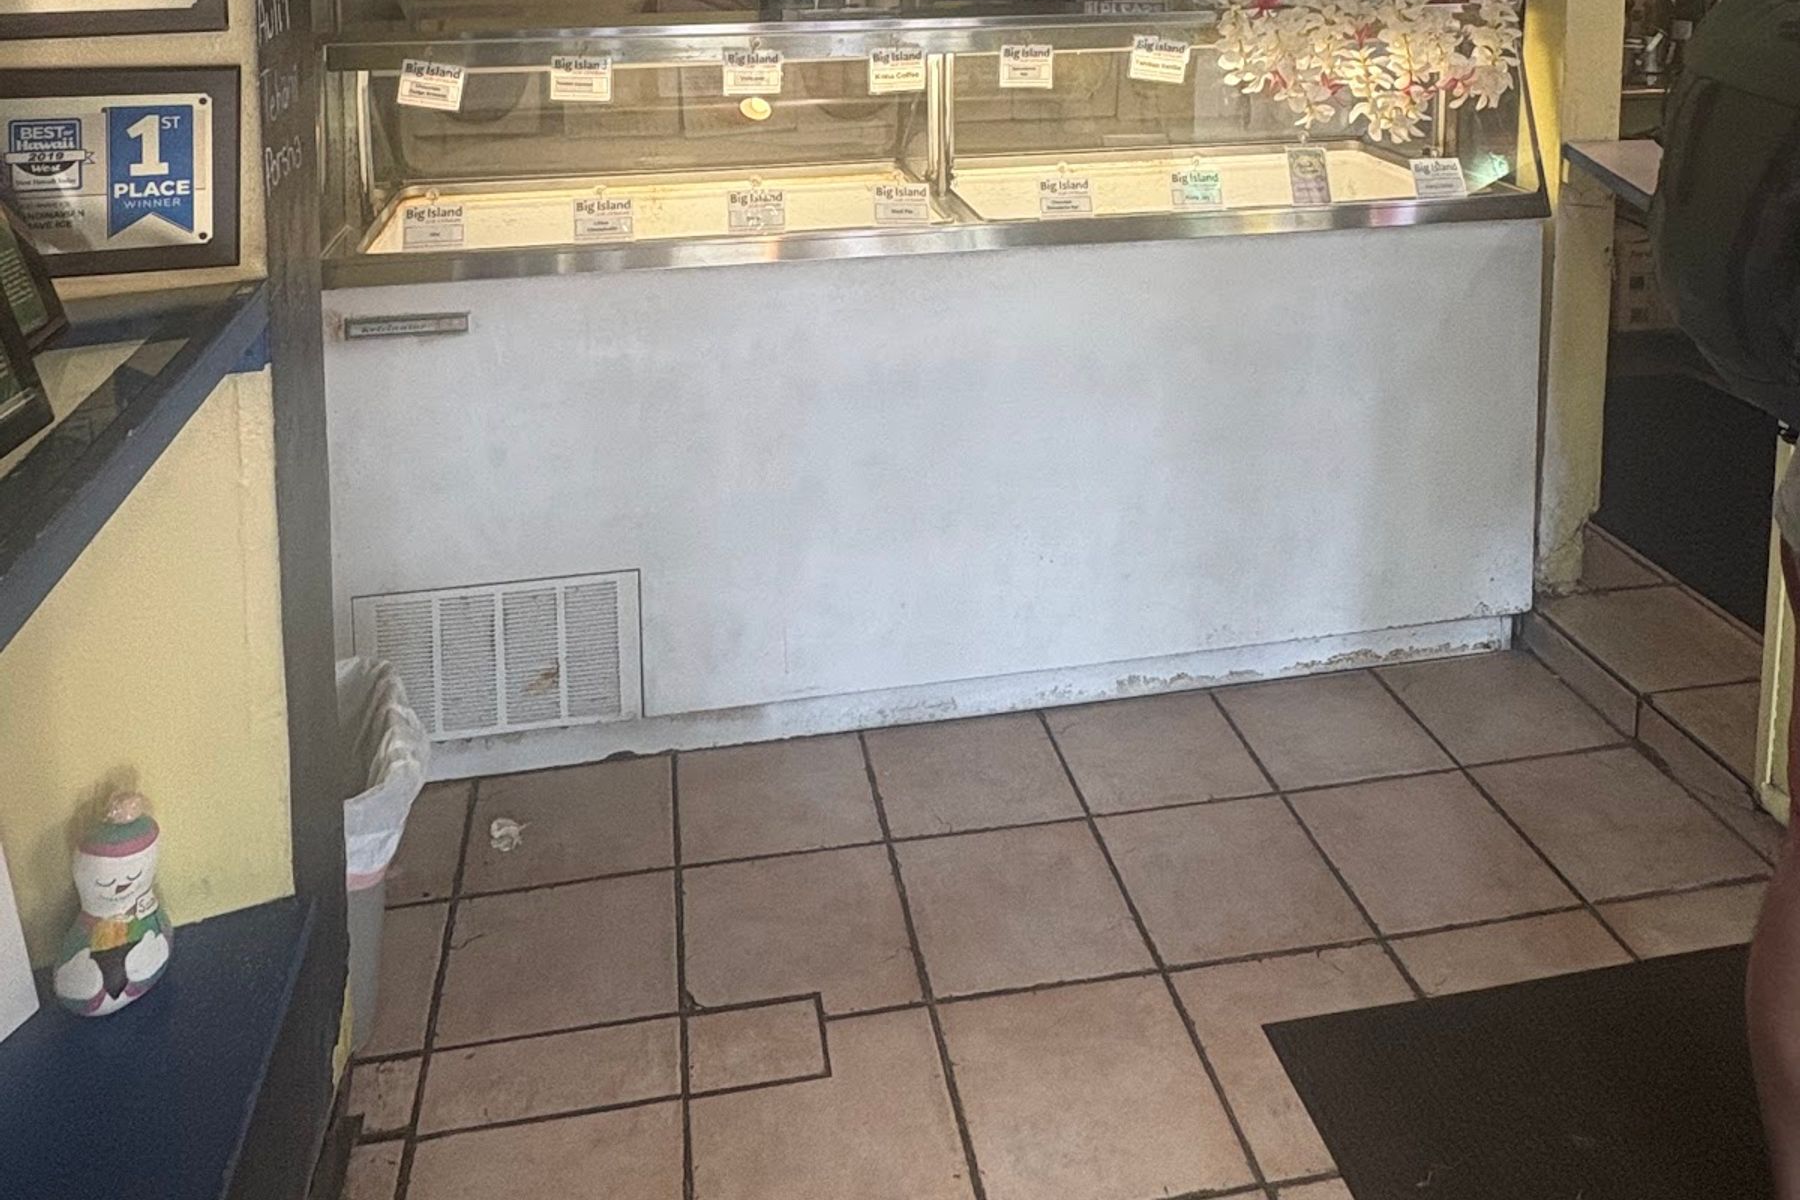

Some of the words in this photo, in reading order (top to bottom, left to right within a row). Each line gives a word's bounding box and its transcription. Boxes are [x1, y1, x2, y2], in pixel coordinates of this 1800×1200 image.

[1003, 46, 1020, 60] Big
[1021, 46, 1050, 58] Island
[1155, 41, 1186, 54] Island
[727, 51, 745, 67] Big
[747, 52, 779, 64] Island
[872, 50, 890, 64] Big
[891, 50, 922, 60] Island
[405, 61, 424, 78] Big
[426, 62, 461, 80] Island
[554, 58, 573, 72] Big
[20, 125, 63, 139] BEST
[16, 137, 75, 151] Hawaii
[28, 151, 65, 161] 2019
[31, 162, 61, 173] West
[1171, 172, 1189, 186] Big
[1190, 172, 1219, 183] Island
[113, 180, 191, 199] PLACE
[876, 187, 893, 200] Big
[895, 187, 926, 198] Island
[1040, 179, 1057, 194] Big
[1059, 179, 1089, 191] Island
[124, 197, 182, 209] WINNER
[730, 193, 748, 207] Big
[406, 208, 425, 222] Big
[427, 206, 463, 218] Island
[576, 201, 595, 215] Big
[597, 200, 631, 211] Island
